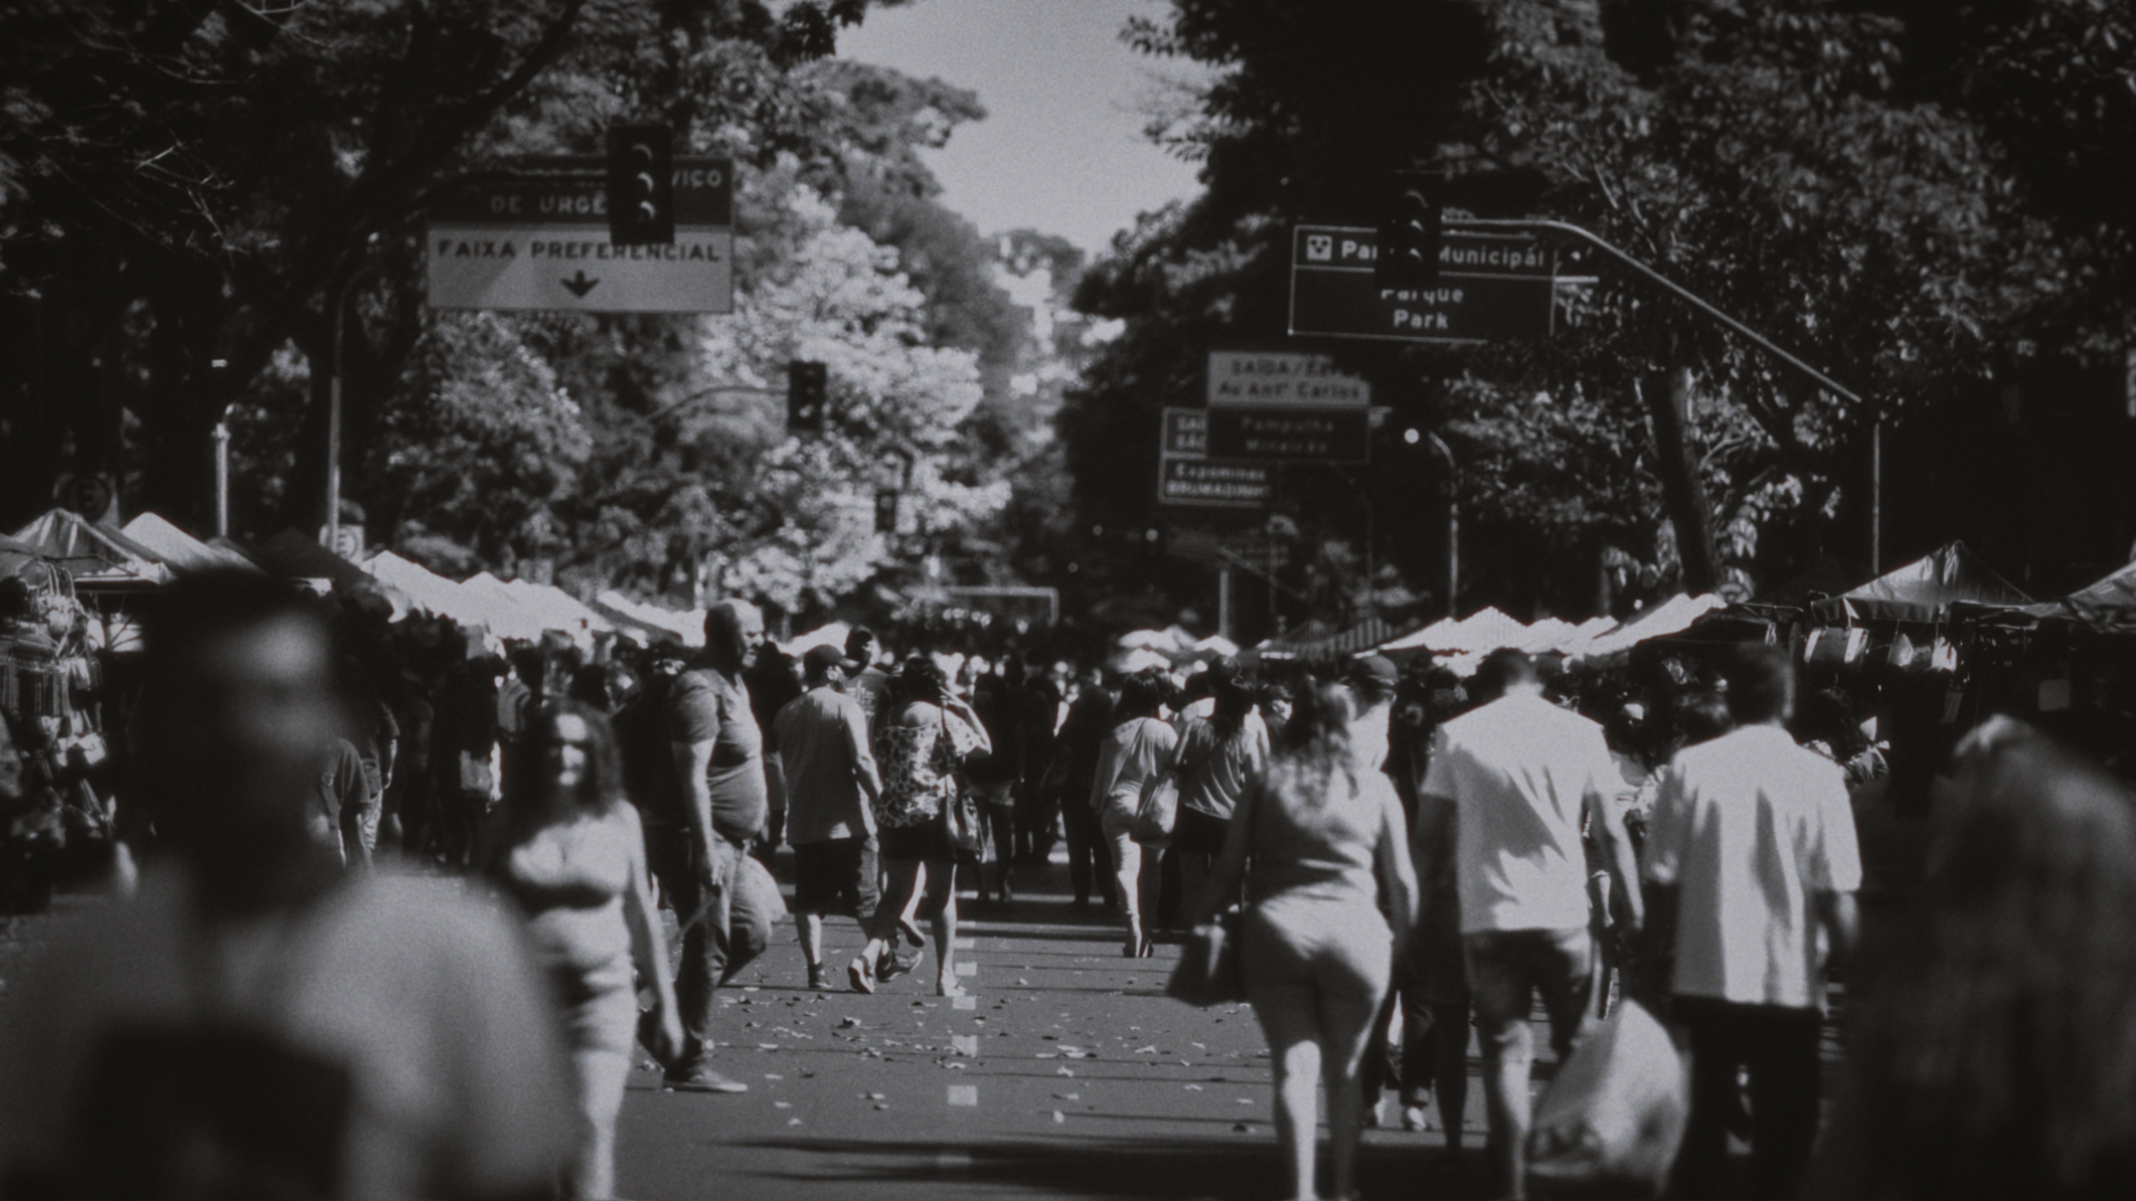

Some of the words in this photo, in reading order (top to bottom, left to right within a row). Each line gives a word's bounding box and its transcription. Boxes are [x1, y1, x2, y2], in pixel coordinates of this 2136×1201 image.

[671, 169, 723, 190] VIÇO
[490, 194, 522, 214] DE
[538, 189, 608, 214] URGÊ
[438, 240, 516, 259] FAIXA
[530, 241, 721, 262] PREFERENCIAL
[1341, 239, 1378, 261] Par
[1392, 308, 1449, 330] Park
[1296, 381, 1360, 399] Carlos
